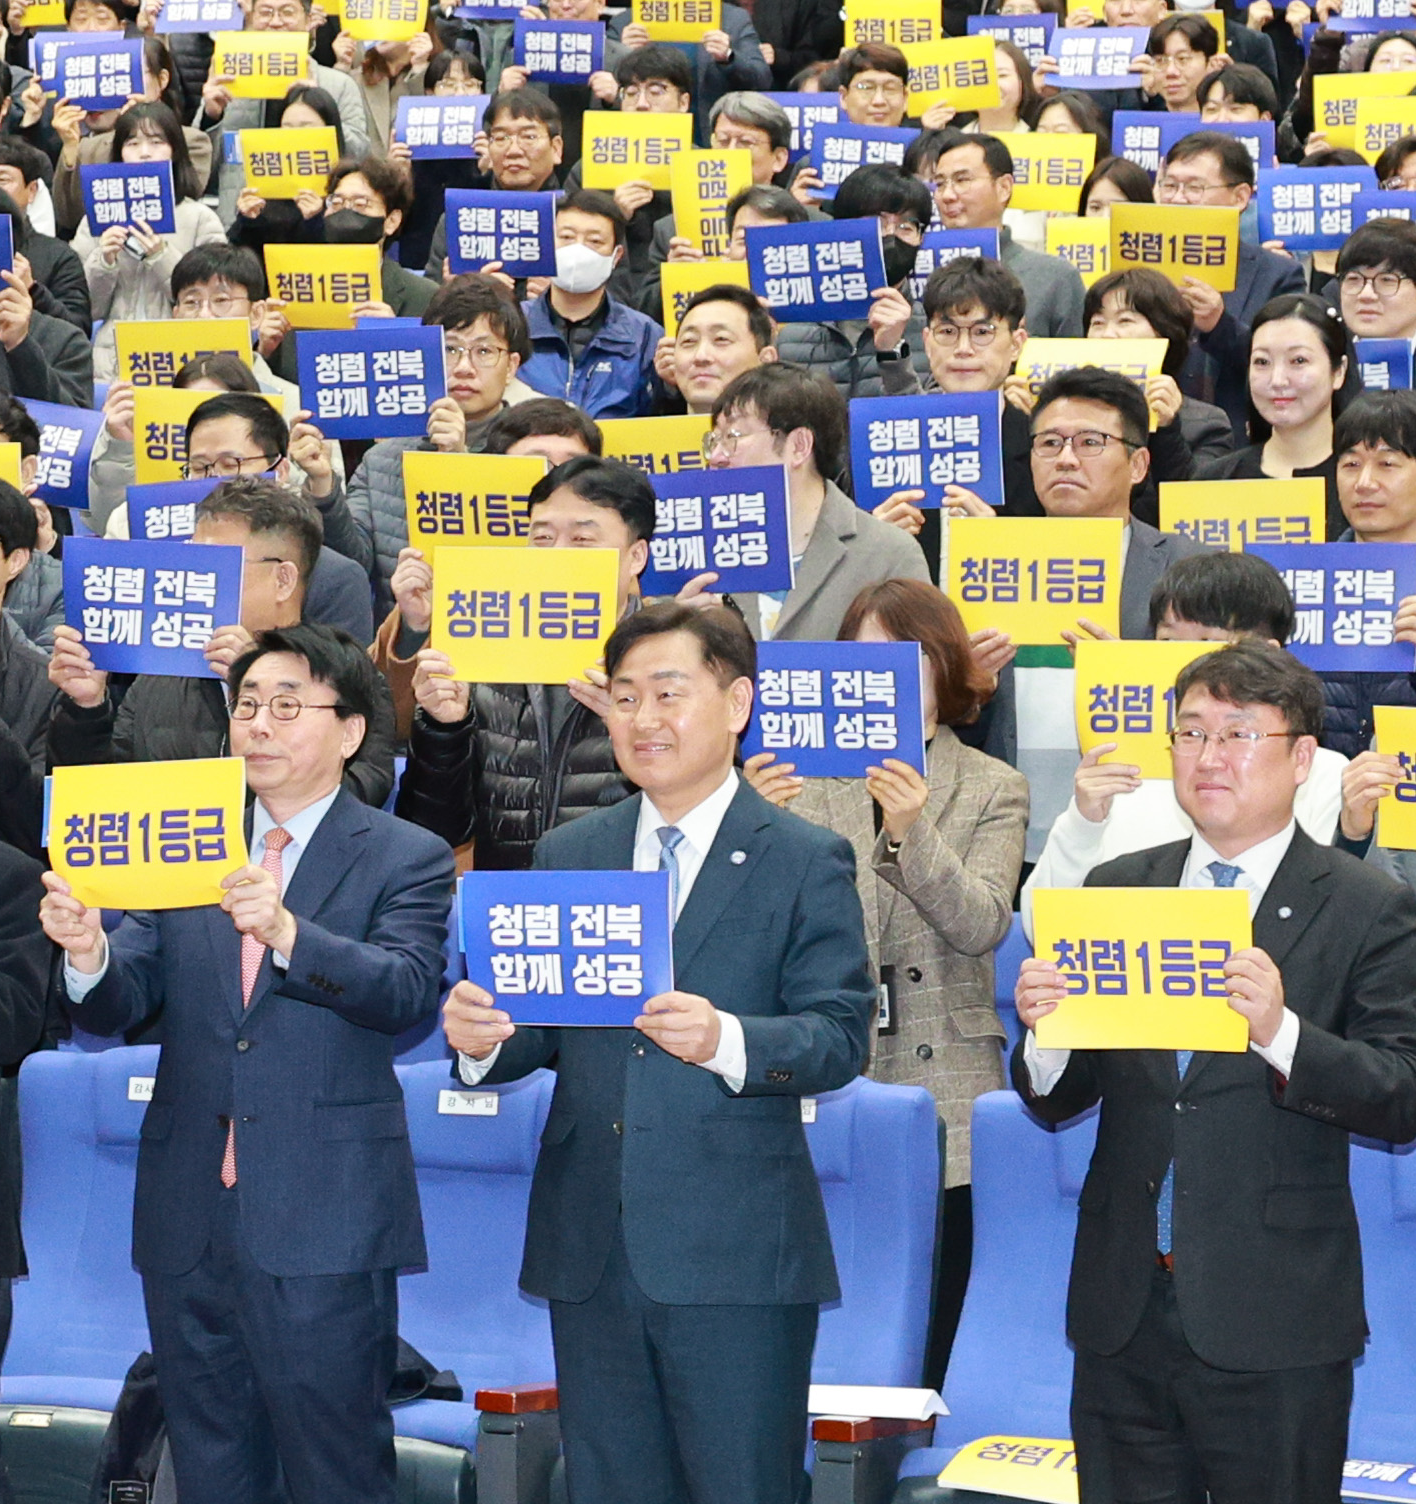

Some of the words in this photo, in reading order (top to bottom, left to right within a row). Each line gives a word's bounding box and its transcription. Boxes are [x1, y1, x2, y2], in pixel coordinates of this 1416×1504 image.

[525, 32, 556, 51] 청렴
[561, 34, 592, 52] 전북
[65, 55, 96, 76] 청렴
[100, 53, 130, 74] 전북
[523, 52, 556, 72] 함께
[560, 54, 591, 73] 성공
[1059, 56, 1092, 76] 함께
[1097, 55, 1130, 75] 성공
[61, 77, 96, 100] 함께
[99, 75, 131, 98] 성공
[405, 128, 439, 147] 함께
[442, 128, 474, 144] 성공
[92, 178, 124, 200] 청렴
[128, 176, 160, 198] 전북
[94, 201, 127, 223] 함께
[130, 199, 162, 221] 성공
[459, 208, 495, 232] 청렴
[501, 210, 539, 234] 전북
[459, 235, 495, 259] 함께
[500, 237, 539, 260] 성공
[763, 244, 809, 274] 청렴
[815, 241, 863, 271] 전북
[765, 277, 814, 306] 함께
[820, 273, 868, 302] 성공
[316, 353, 365, 383] 청렴
[373, 350, 423, 381] 전북
[317, 387, 368, 418] 함께
[376, 385, 426, 415] 성공
[869, 419, 919, 451] 청렴
[928, 415, 979, 448] 전북
[870, 455, 921, 487] 함께
[930, 451, 980, 483] 성공
[654, 497, 702, 532] 청렴
[711, 493, 765, 528] 전북
[650, 536, 705, 571] 함께
[713, 532, 768, 567] 성공
[84, 566, 144, 603] 청렴
[154, 571, 216, 607] 전북
[961, 558, 1105, 603] 청렴1등급
[1334, 570, 1394, 604] 전북
[83, 607, 142, 645] 함께
[152, 612, 214, 648] 성공
[447, 590, 601, 639] 청렴1등급
[1333, 611, 1396, 645] 성공
[759, 670, 821, 706] 청렴
[832, 671, 895, 707] 전북
[760, 712, 824, 748] 함께
[834, 714, 897, 749] 성공
[64, 808, 227, 867] 청렴1등급
[489, 904, 559, 945] 청렴
[571, 905, 641, 946] 전북
[491, 953, 563, 994] 함께
[573, 954, 642, 995] 성공
[1049, 939, 1230, 997] 청렴1등급
